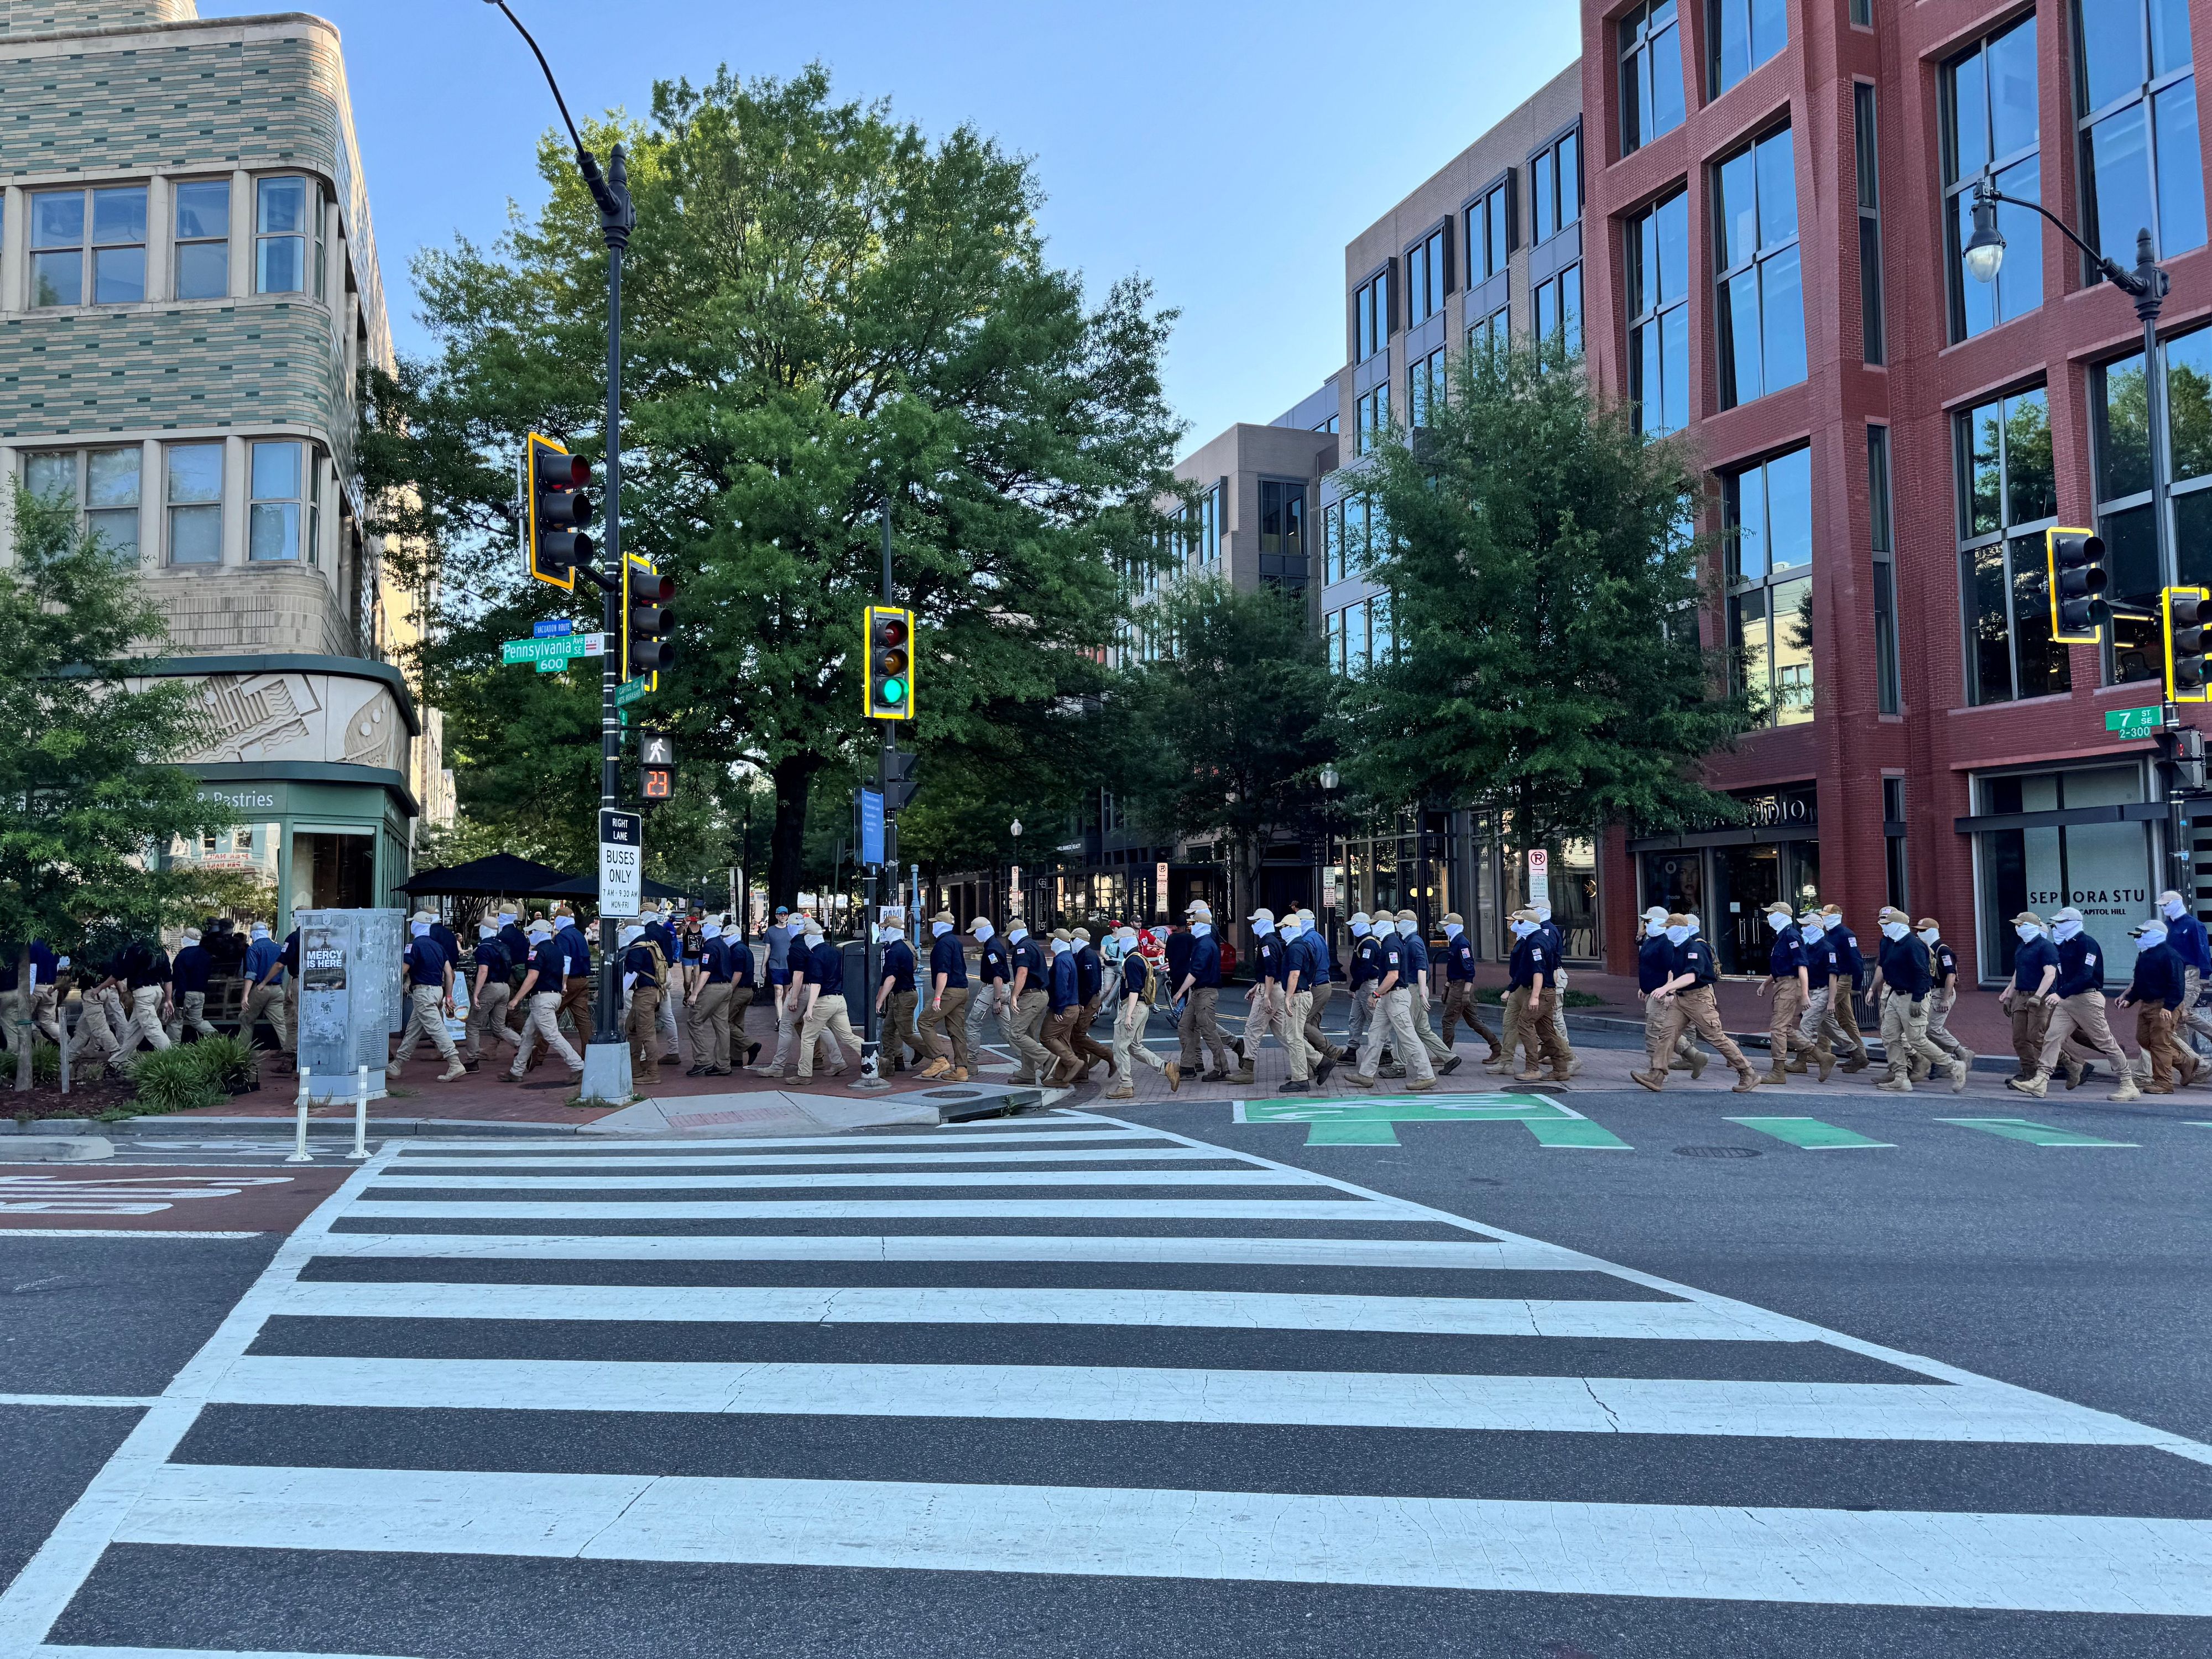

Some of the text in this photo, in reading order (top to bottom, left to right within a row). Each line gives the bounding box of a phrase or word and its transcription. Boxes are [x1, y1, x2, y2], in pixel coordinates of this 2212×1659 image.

[535, 623, 570, 634] EVACUATION ROUTE
[504, 639, 571, 660] Pennsylvania
[574, 646, 582, 655] SE
[541, 659, 563, 670] 600
[619, 684, 632, 695] CAPITOL
[2119, 712, 2130, 727] 7
[2120, 727, 2150, 738] 2-300
[647, 770, 667, 796] 23
[214, 791, 273, 807] Pastries
[612, 818, 628, 828] RIGHT
[613, 831, 628, 841] LANE
[607, 849, 634, 865] BUSES
[609, 869, 632, 883] ONLY
[2031, 889, 2145, 904] SEPORA STU
[307, 950, 343, 960] MERCY
[307, 959, 342, 968] IS HERE
